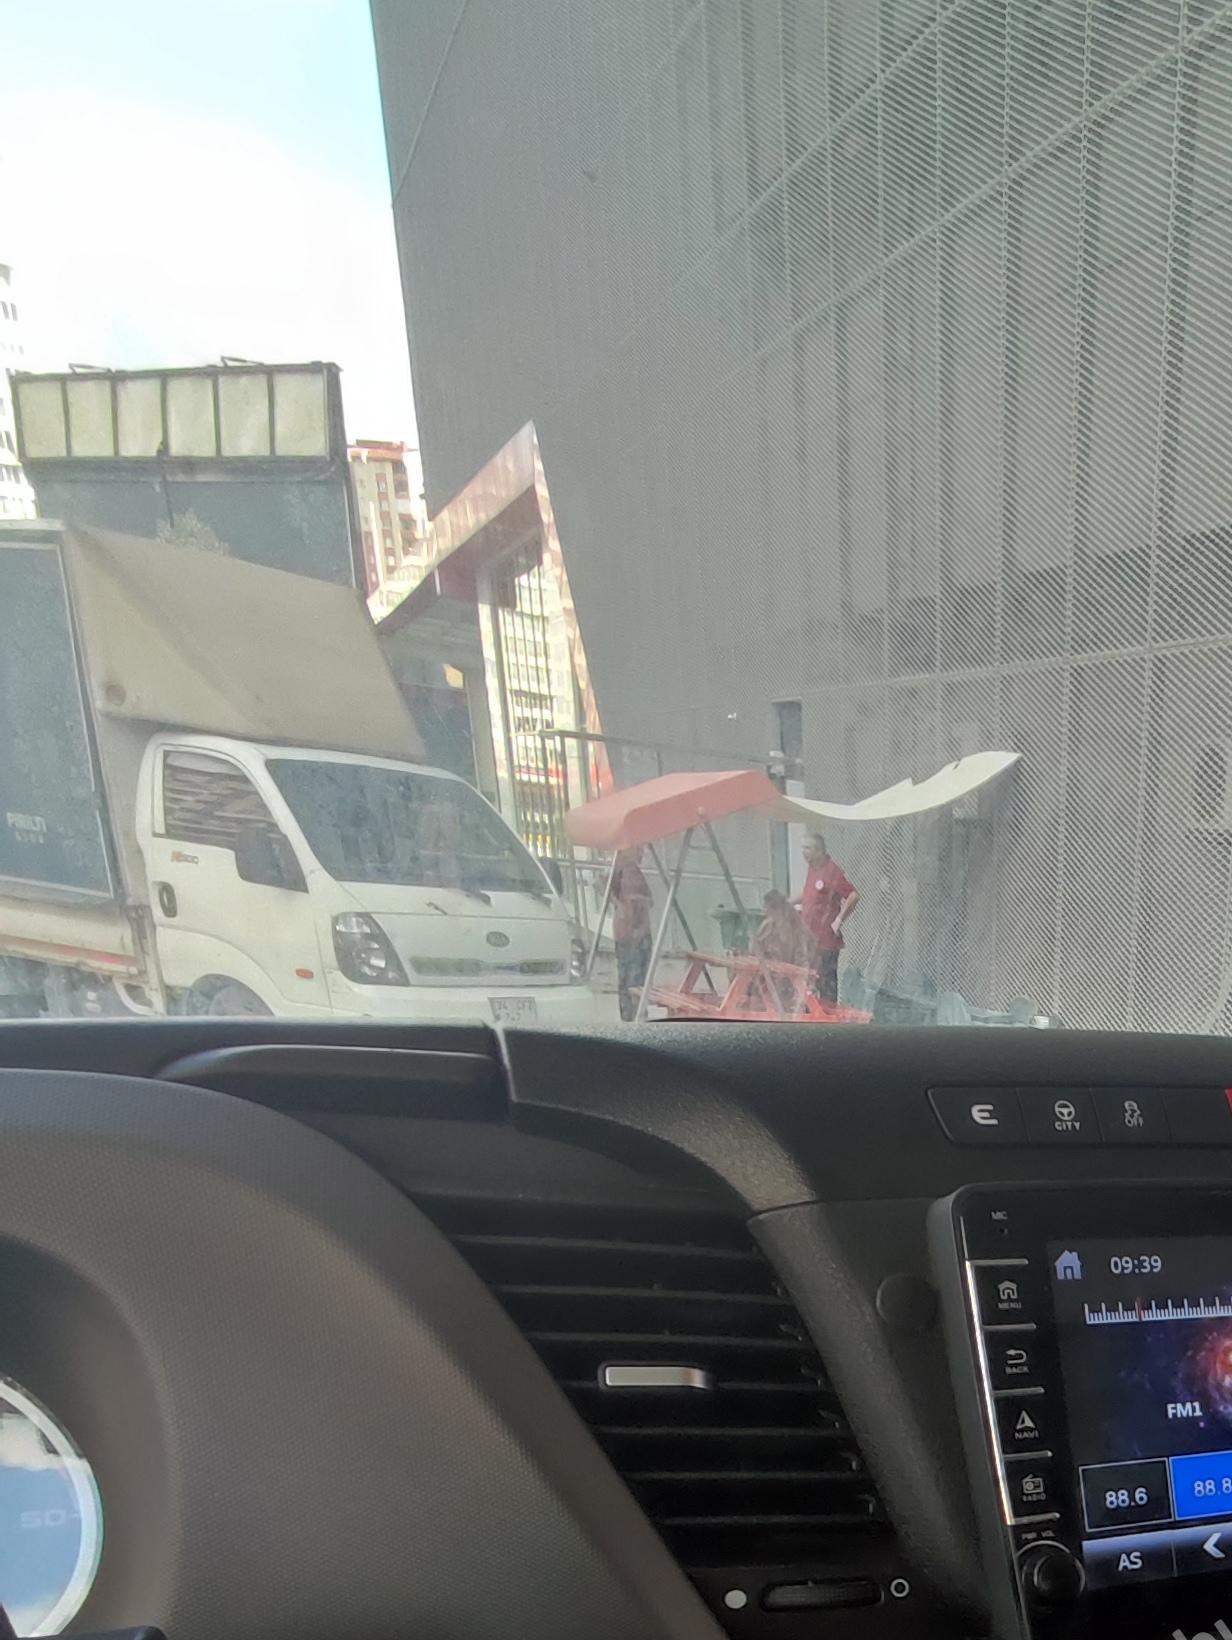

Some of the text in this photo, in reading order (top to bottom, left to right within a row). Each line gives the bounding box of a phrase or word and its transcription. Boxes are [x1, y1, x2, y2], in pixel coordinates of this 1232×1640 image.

[1054, 1120, 1081, 1132] CITY
[1110, 1255, 1162, 1275] 09:39
[1166, 1400, 1203, 1419] FM1
[1014, 1430, 1039, 1440] NAVI
[1104, 1487, 1148, 1510] 88.6
[1193, 1477, 1232, 1498] 88.8
[1117, 1551, 1143, 1572] AS
